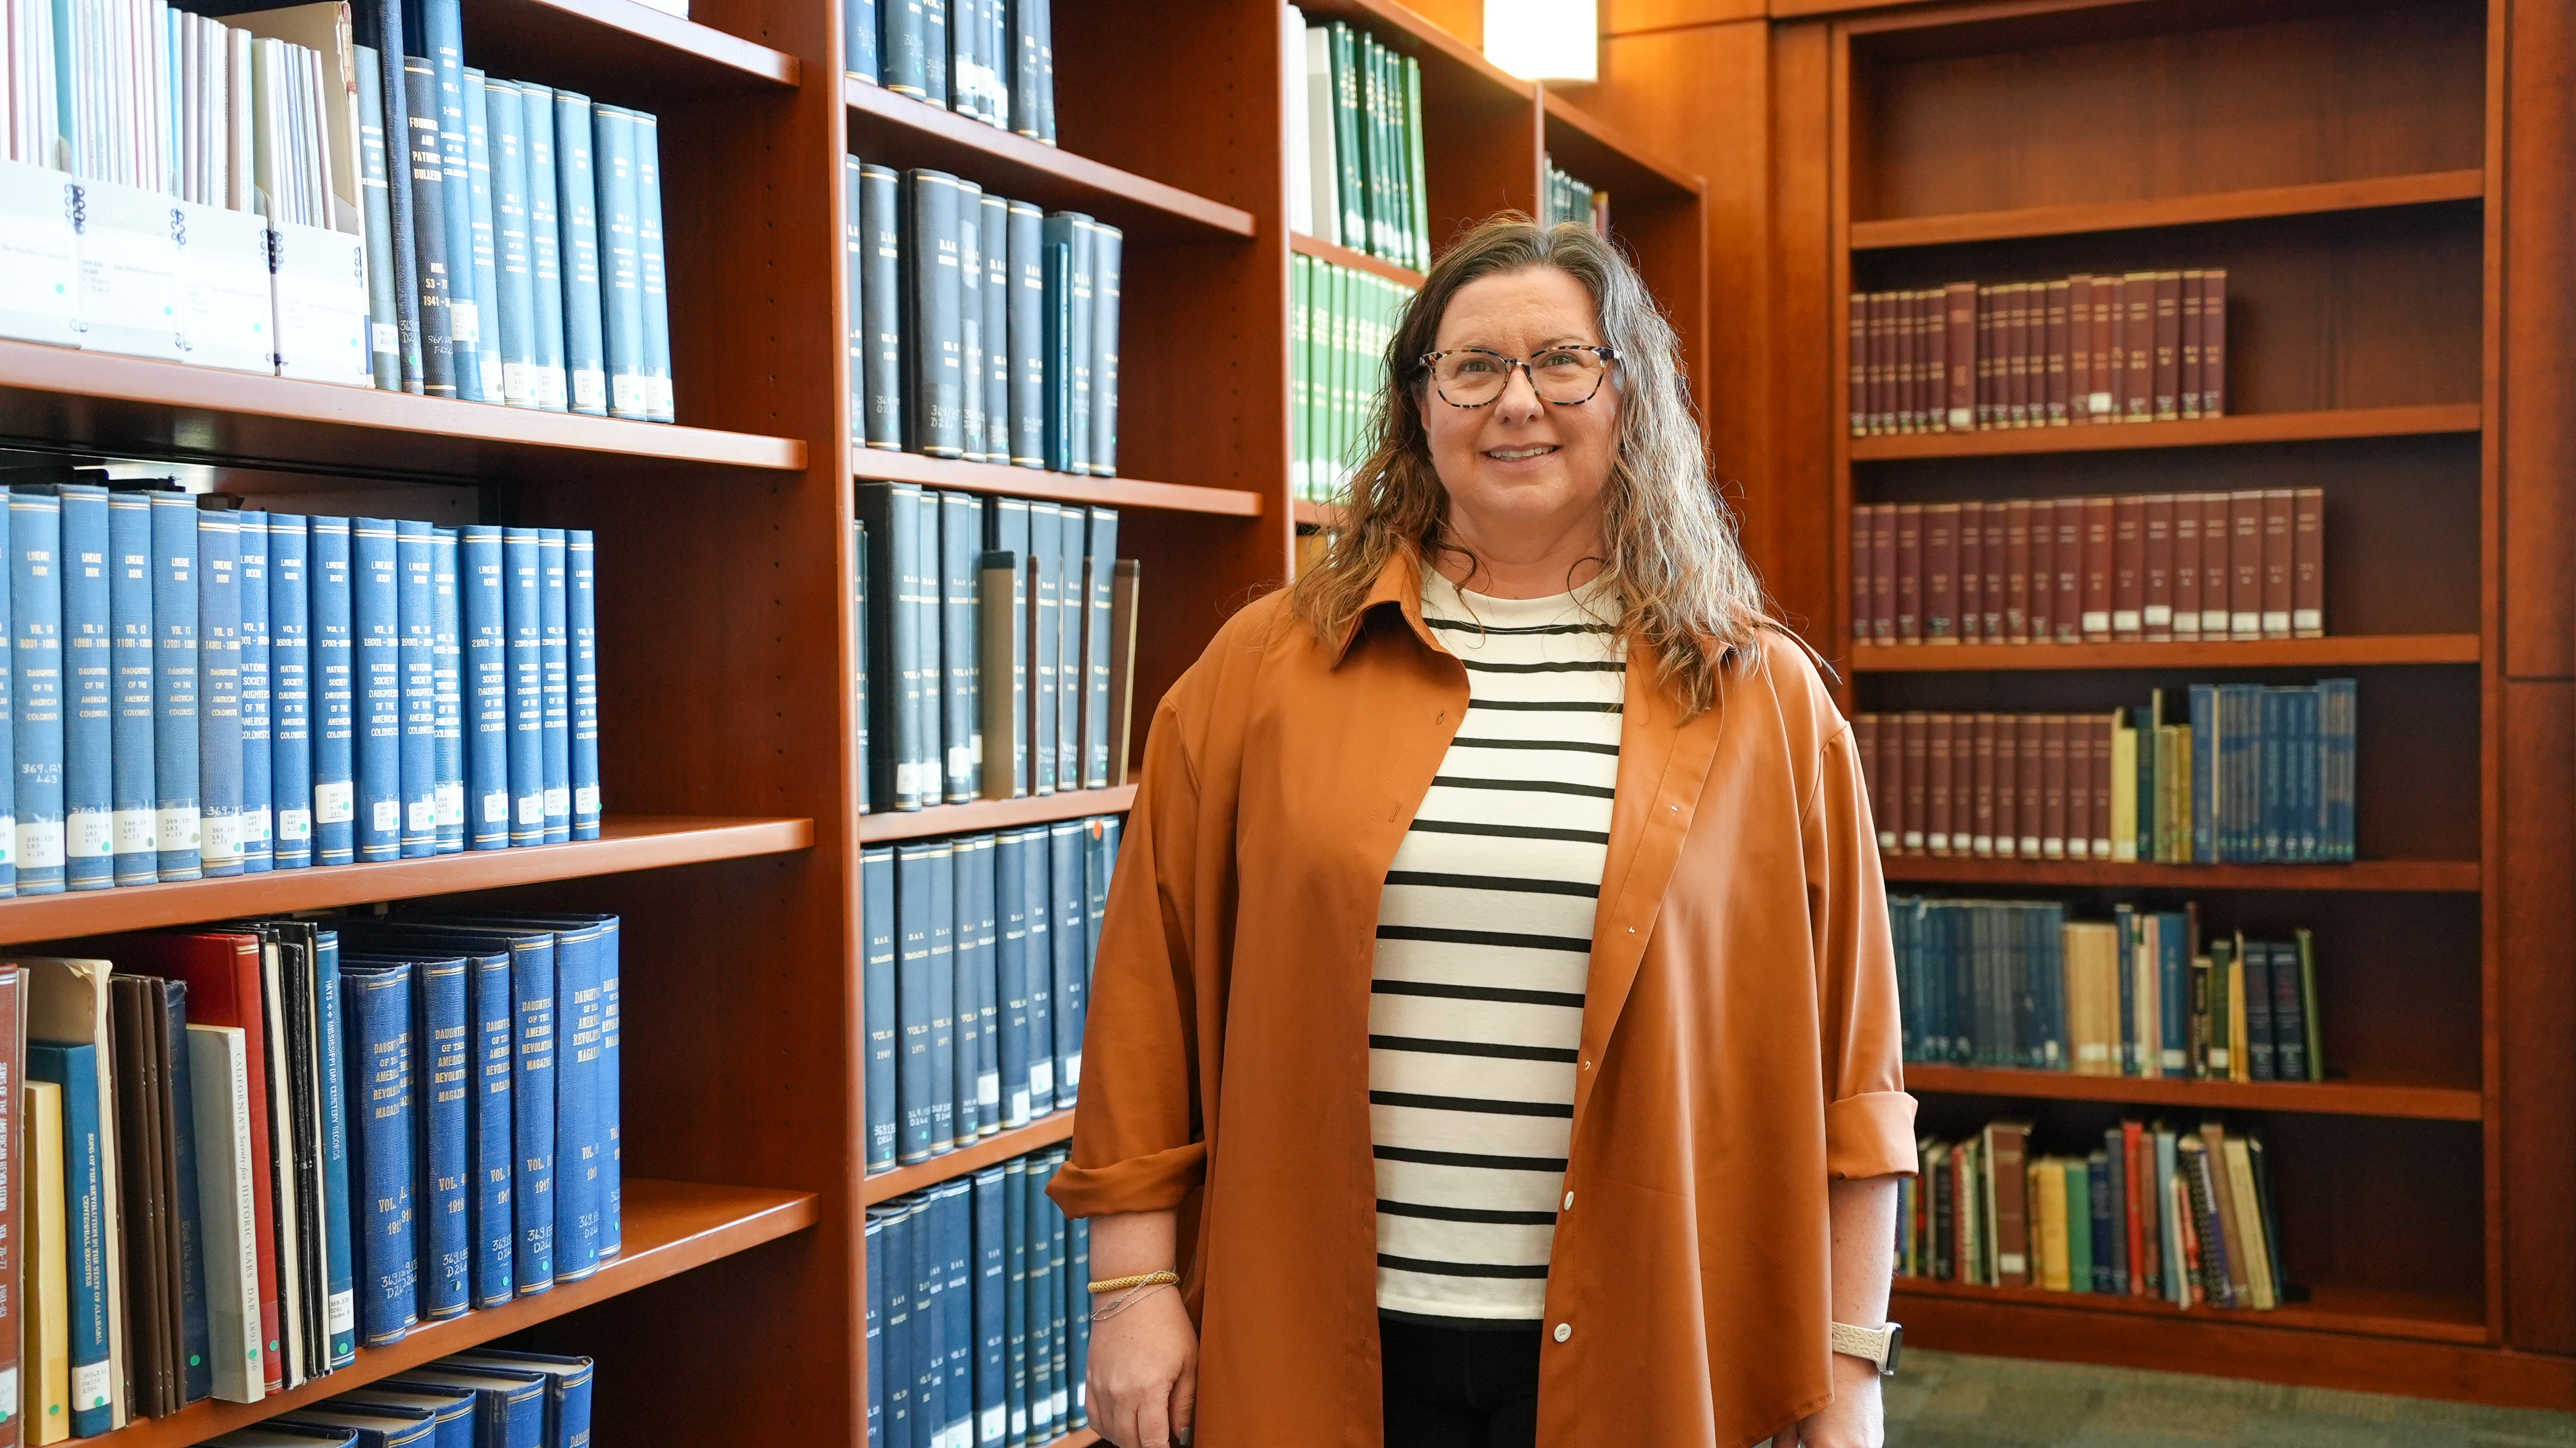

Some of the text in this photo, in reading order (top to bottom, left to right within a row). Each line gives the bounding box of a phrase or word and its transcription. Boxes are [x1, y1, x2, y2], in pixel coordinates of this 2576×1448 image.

[422, 135, 434, 146] AND
[241, 555, 265, 565] LINEAGE
[246, 569, 262, 578] BOOK
[227, 627, 233, 637] 15
[244, 623, 258, 632] VOL.
[243, 677, 267, 686] SOCIETY
[374, 677, 396, 686] SOCIETY
[411, 676, 432, 685] SOCIETY
[242, 690, 270, 699] AUGHTERS
[245, 703, 265, 712] OF THE
[376, 702, 394, 711] OF THE
[413, 700, 431, 710] OF THE
[36, 774, 57, 784] L63
[326, 1020, 335, 1067] MISSISSIPPI
[492, 1036, 499, 1045] OF
[236, 1053, 245, 1130] CALIFORNIA'S
[330, 1085, 339, 1123] CEMETERY
[331, 1125, 340, 1159] RECORDS
[239, 1136, 248, 1180] Seventy-five
[527, 1158, 544, 1172] VOL.
[490, 1167, 505, 1182] VOL.
[439, 1176, 457, 1191] VOL.
[535, 1178, 550, 1194] 1917
[90, 1185, 98, 1238] REVOLUTION
[242, 1185, 251, 1239] HISTORIC
